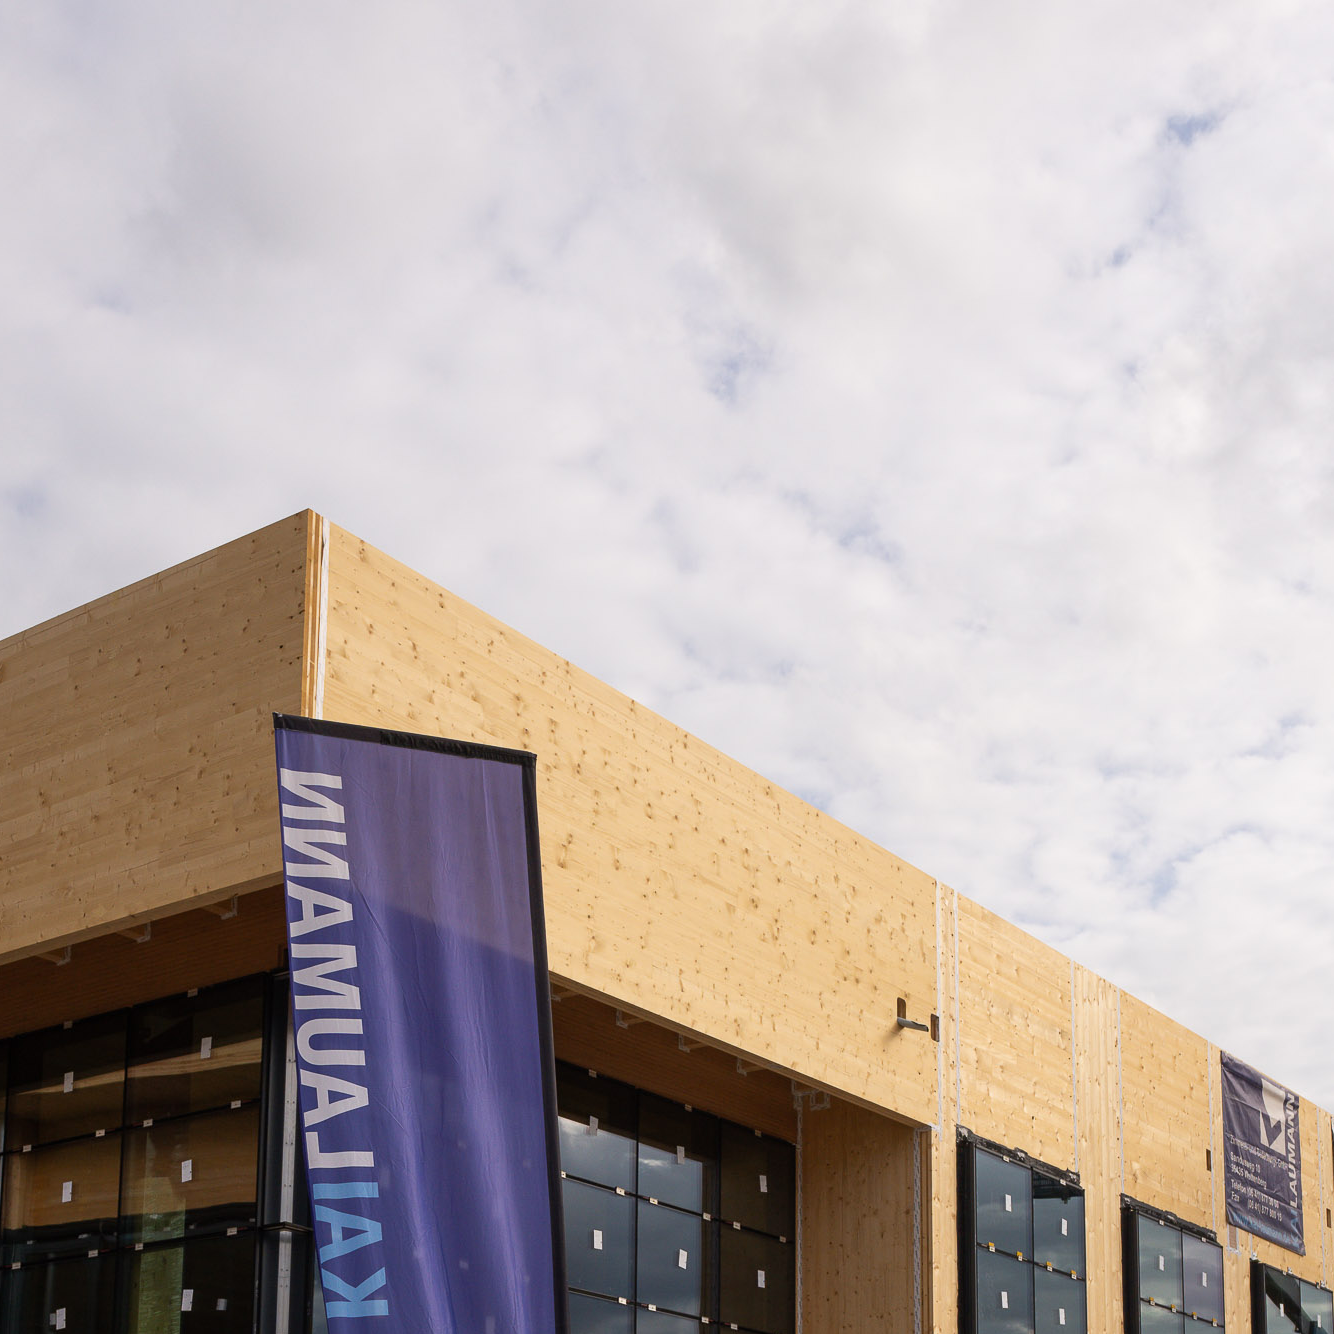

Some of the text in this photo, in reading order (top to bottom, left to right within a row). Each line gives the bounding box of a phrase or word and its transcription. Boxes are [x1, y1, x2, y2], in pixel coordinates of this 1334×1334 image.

[1231, 1191, 1240, 1202] Fax
[1286, 1092, 1300, 1248] KAI LAUMANN
